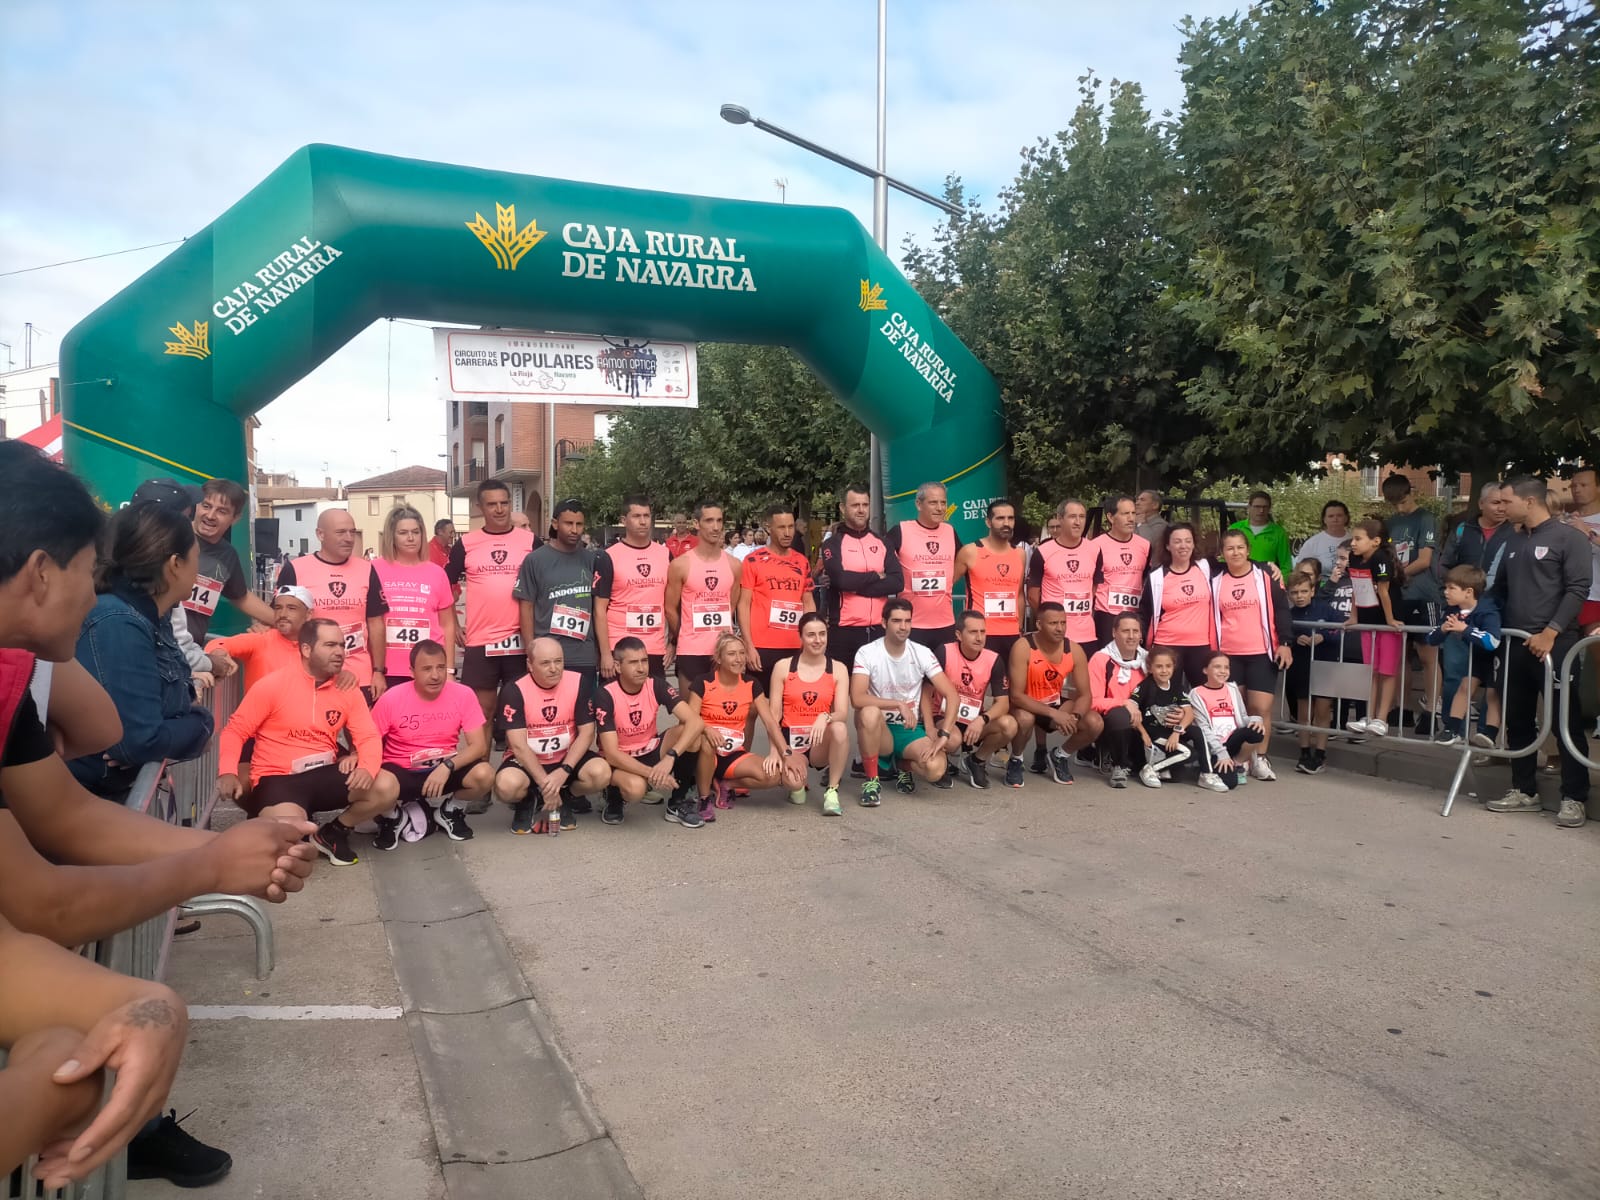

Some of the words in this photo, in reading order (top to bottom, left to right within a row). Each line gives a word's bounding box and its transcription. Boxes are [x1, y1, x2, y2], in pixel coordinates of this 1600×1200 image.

[562, 222, 640, 254] CAJA
[645, 230, 745, 263] RURAL
[212, 281, 262, 319] CAJA
[255, 235, 321, 287] RURAL
[561, 251, 606, 280] DE
[615, 256, 757, 292] NAVARRA
[224, 306, 259, 335] DE
[254, 244, 343, 314] NAVARRA
[454, 350, 487, 358] CIRCUITO
[890, 312, 920, 347] CAJA
[918, 341, 957, 387] RURAL
[455, 358, 498, 367] CARRERAS
[500, 352, 594, 370] POPULARES
[880, 320, 903, 345] DE
[898, 341, 954, 403] NAVARRA
[962, 498, 988, 510] CAJA
[963, 509, 979, 520] DE
[921, 578, 940, 590] 22
[192, 586, 210, 605] 14
[548, 585, 592, 599] ANDOSILL
[314, 598, 364, 607] ANDOSILLA
[998, 600, 1005, 611] 1
[1067, 600, 1090, 612] 149
[1113, 594, 1138, 607] 180
[636, 614, 655, 626] 16
[703, 613, 722, 626] 69
[779, 610, 797, 623] 59
[557, 615, 585, 633] 191
[396, 628, 419, 642] 48
[345, 635, 356, 650] 2
[399, 714, 420, 731] 25
[538, 737, 561, 752] 73
[721, 738, 734, 751] 6
